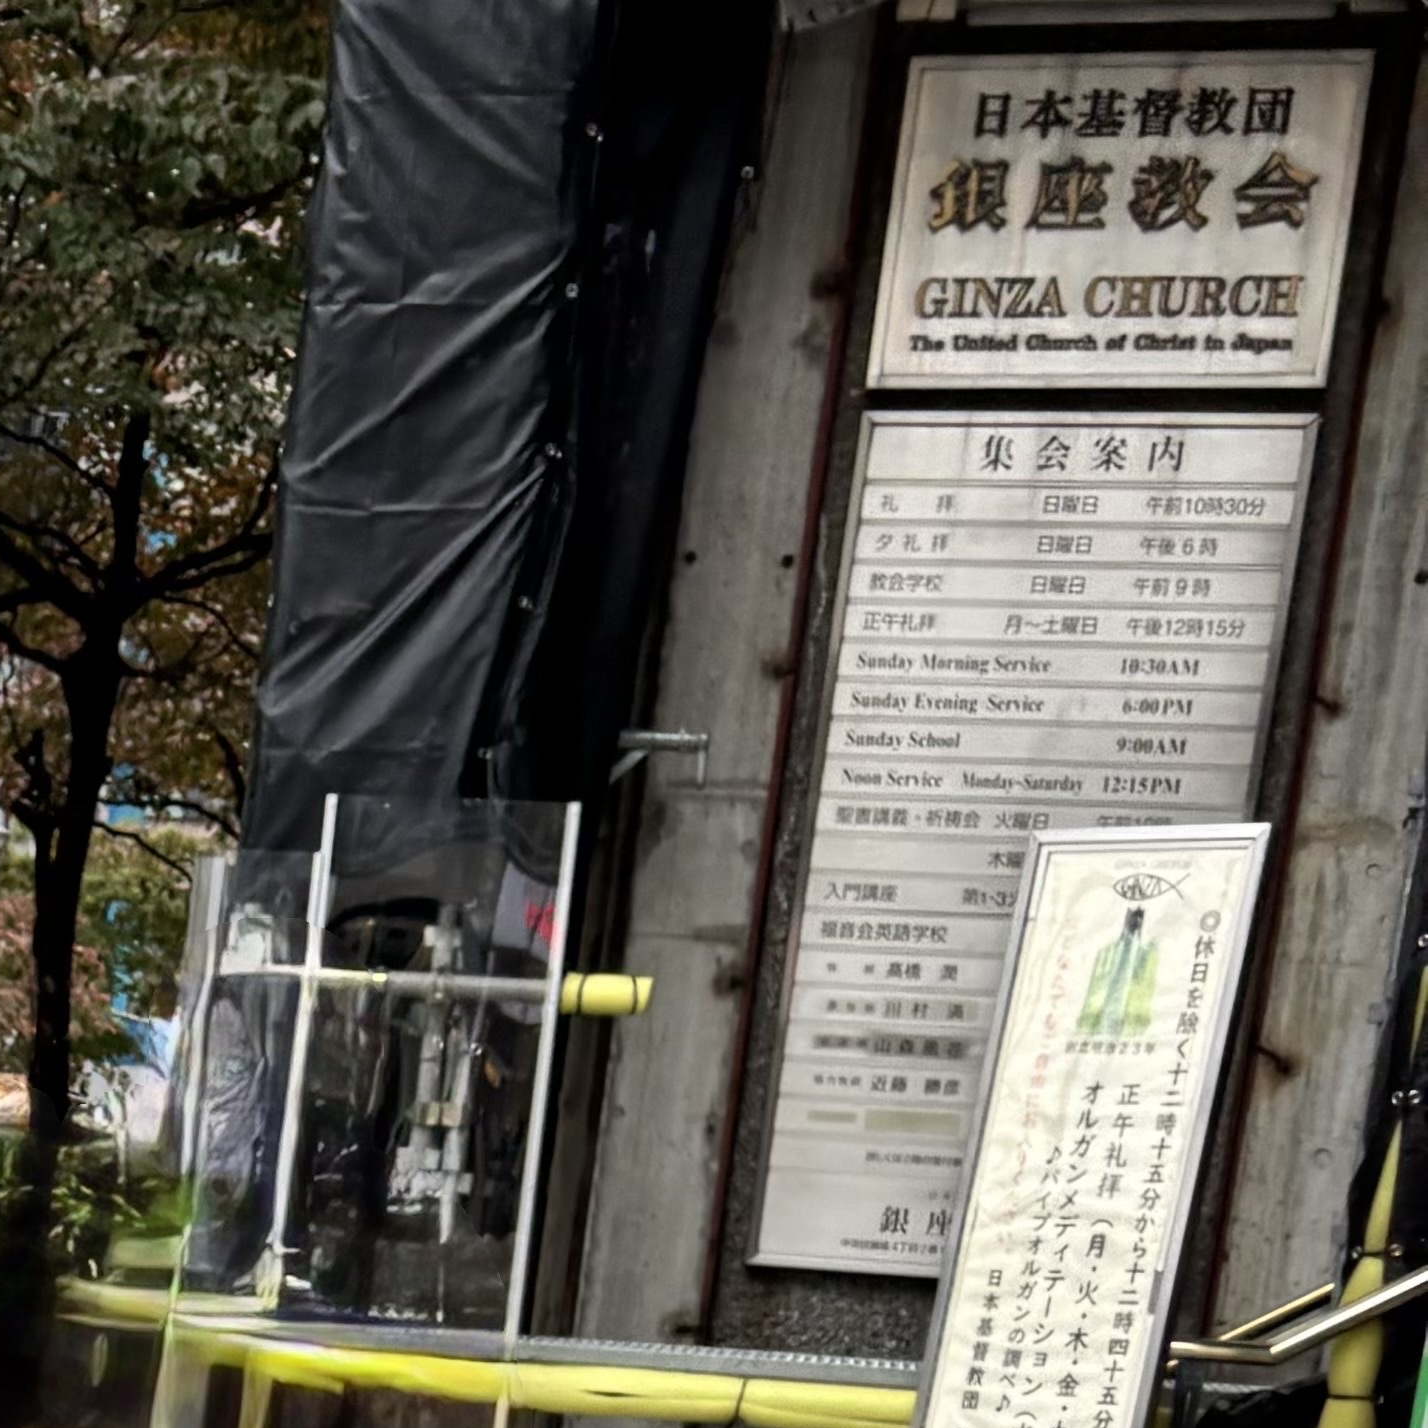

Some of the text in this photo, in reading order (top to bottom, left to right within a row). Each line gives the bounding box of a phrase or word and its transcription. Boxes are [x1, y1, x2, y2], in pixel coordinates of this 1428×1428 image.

[974, 86, 1296, 139] 日本基督教団
[929, 150, 1321, 234] 銀座教会
[913, 275, 1304, 319] GINZA CHURCH
[910, 334, 1294, 354] The United Church of Christ in Japan
[980, 434, 1185, 471] 集会案内
[1042, 495, 1099, 514] 日曜日
[1146, 496, 1266, 516] 午前10時30分
[1036, 534, 1093, 554] 日曜日
[1140, 537, 1219, 557] 午後6時
[869, 572, 1211, 597] 教会学校 日曜日 午前9時
[1126, 617, 1246, 638] 午後12時15分
[856, 651, 913, 672] Sunday
[921, 653, 990, 675] Morning
[993, 655, 1052, 674] Service
[850, 691, 908, 713] Sunday
[914, 693, 978, 714] Evening
[985, 694, 1045, 713] Service
[844, 729, 903, 751] Sunday
[908, 731, 961, 749] School
[841, 767, 882, 786] Noon
[886, 769, 944, 788] Service
[994, 810, 1050, 830] 火曜日
[987, 849, 1026, 869] 木曜
[823, 882, 898, 903] 入門講座
[880, 1205, 952, 1237] 銀座
